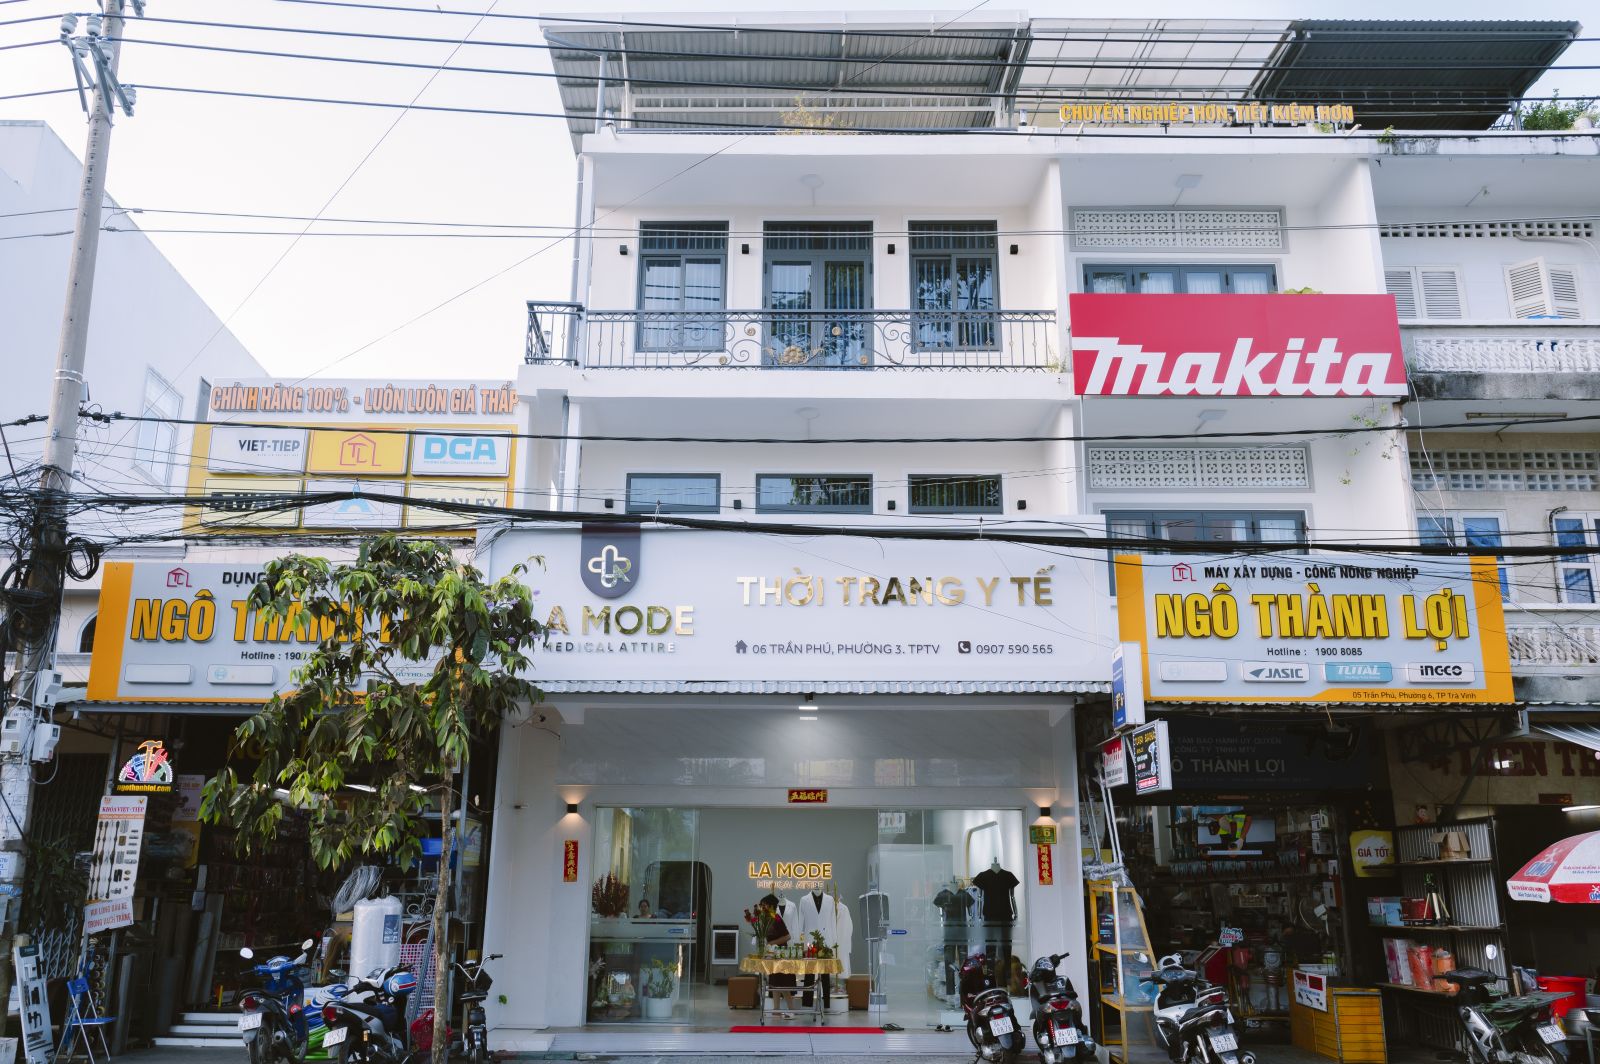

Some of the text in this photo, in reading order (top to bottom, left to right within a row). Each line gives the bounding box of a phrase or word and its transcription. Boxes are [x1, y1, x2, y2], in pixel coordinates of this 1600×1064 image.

[1060, 103, 1124, 122] CHUYÊN
[1129, 103, 1190, 123] NGHIỆP
[1235, 101, 1268, 122] TIẾT
[1272, 102, 1315, 124] KIỆM
[1317, 104, 1354, 122] HƠN
[1072, 337, 1406, 396] makita
[211, 382, 259, 412] CHÍNH
[261, 383, 303, 412] HÃNG
[307, 386, 348, 412] 100%
[364, 384, 405, 413] LUÔN
[407, 384, 447, 413] LUÔN
[451, 384, 476, 413] GIÁ
[480, 381, 519, 414] THẤP
[239, 440, 300, 451] VIET-TIEP
[424, 437, 497, 460] DCA
[1204, 564, 1229, 578] MÁY
[1234, 564, 1256, 578] XÂY
[1261, 565, 1293, 580] DỰNG
[1305, 564, 1336, 578] CÔNG
[736, 564, 1056, 606] THỜI TRANG Y TẾ
[130, 588, 217, 643] NGÔ
[546, 605, 695, 636] A MODE
[1154, 583, 1471, 651] NGÔ THÀNH LỢI
[543, 642, 676, 653] MEDICAL ATTIRE
[752, 645, 767, 655] 06
[770, 640, 803, 655] TRẦN
[837, 641, 892, 655] PHƯỜNG
[908, 644, 940, 655] TPTV
[976, 644, 1053, 655] 0907 590 565
[1267, 647, 1301, 657] Hotline
[1315, 647, 1338, 657] 1900
[1340, 647, 1363, 657] 8085
[241, 651, 275, 661] Hotline
[1265, 667, 1304, 679] JASIC
[1353, 692, 1361, 700] 05
[1436, 692, 1446, 700] TP
[1448, 691, 1460, 700] Trà
[1461, 691, 1477, 700] Vinh
[1191, 755, 1249, 773] THÀNH
[1358, 846, 1372, 857] GIÁ
[749, 862, 832, 879] LA MODE
